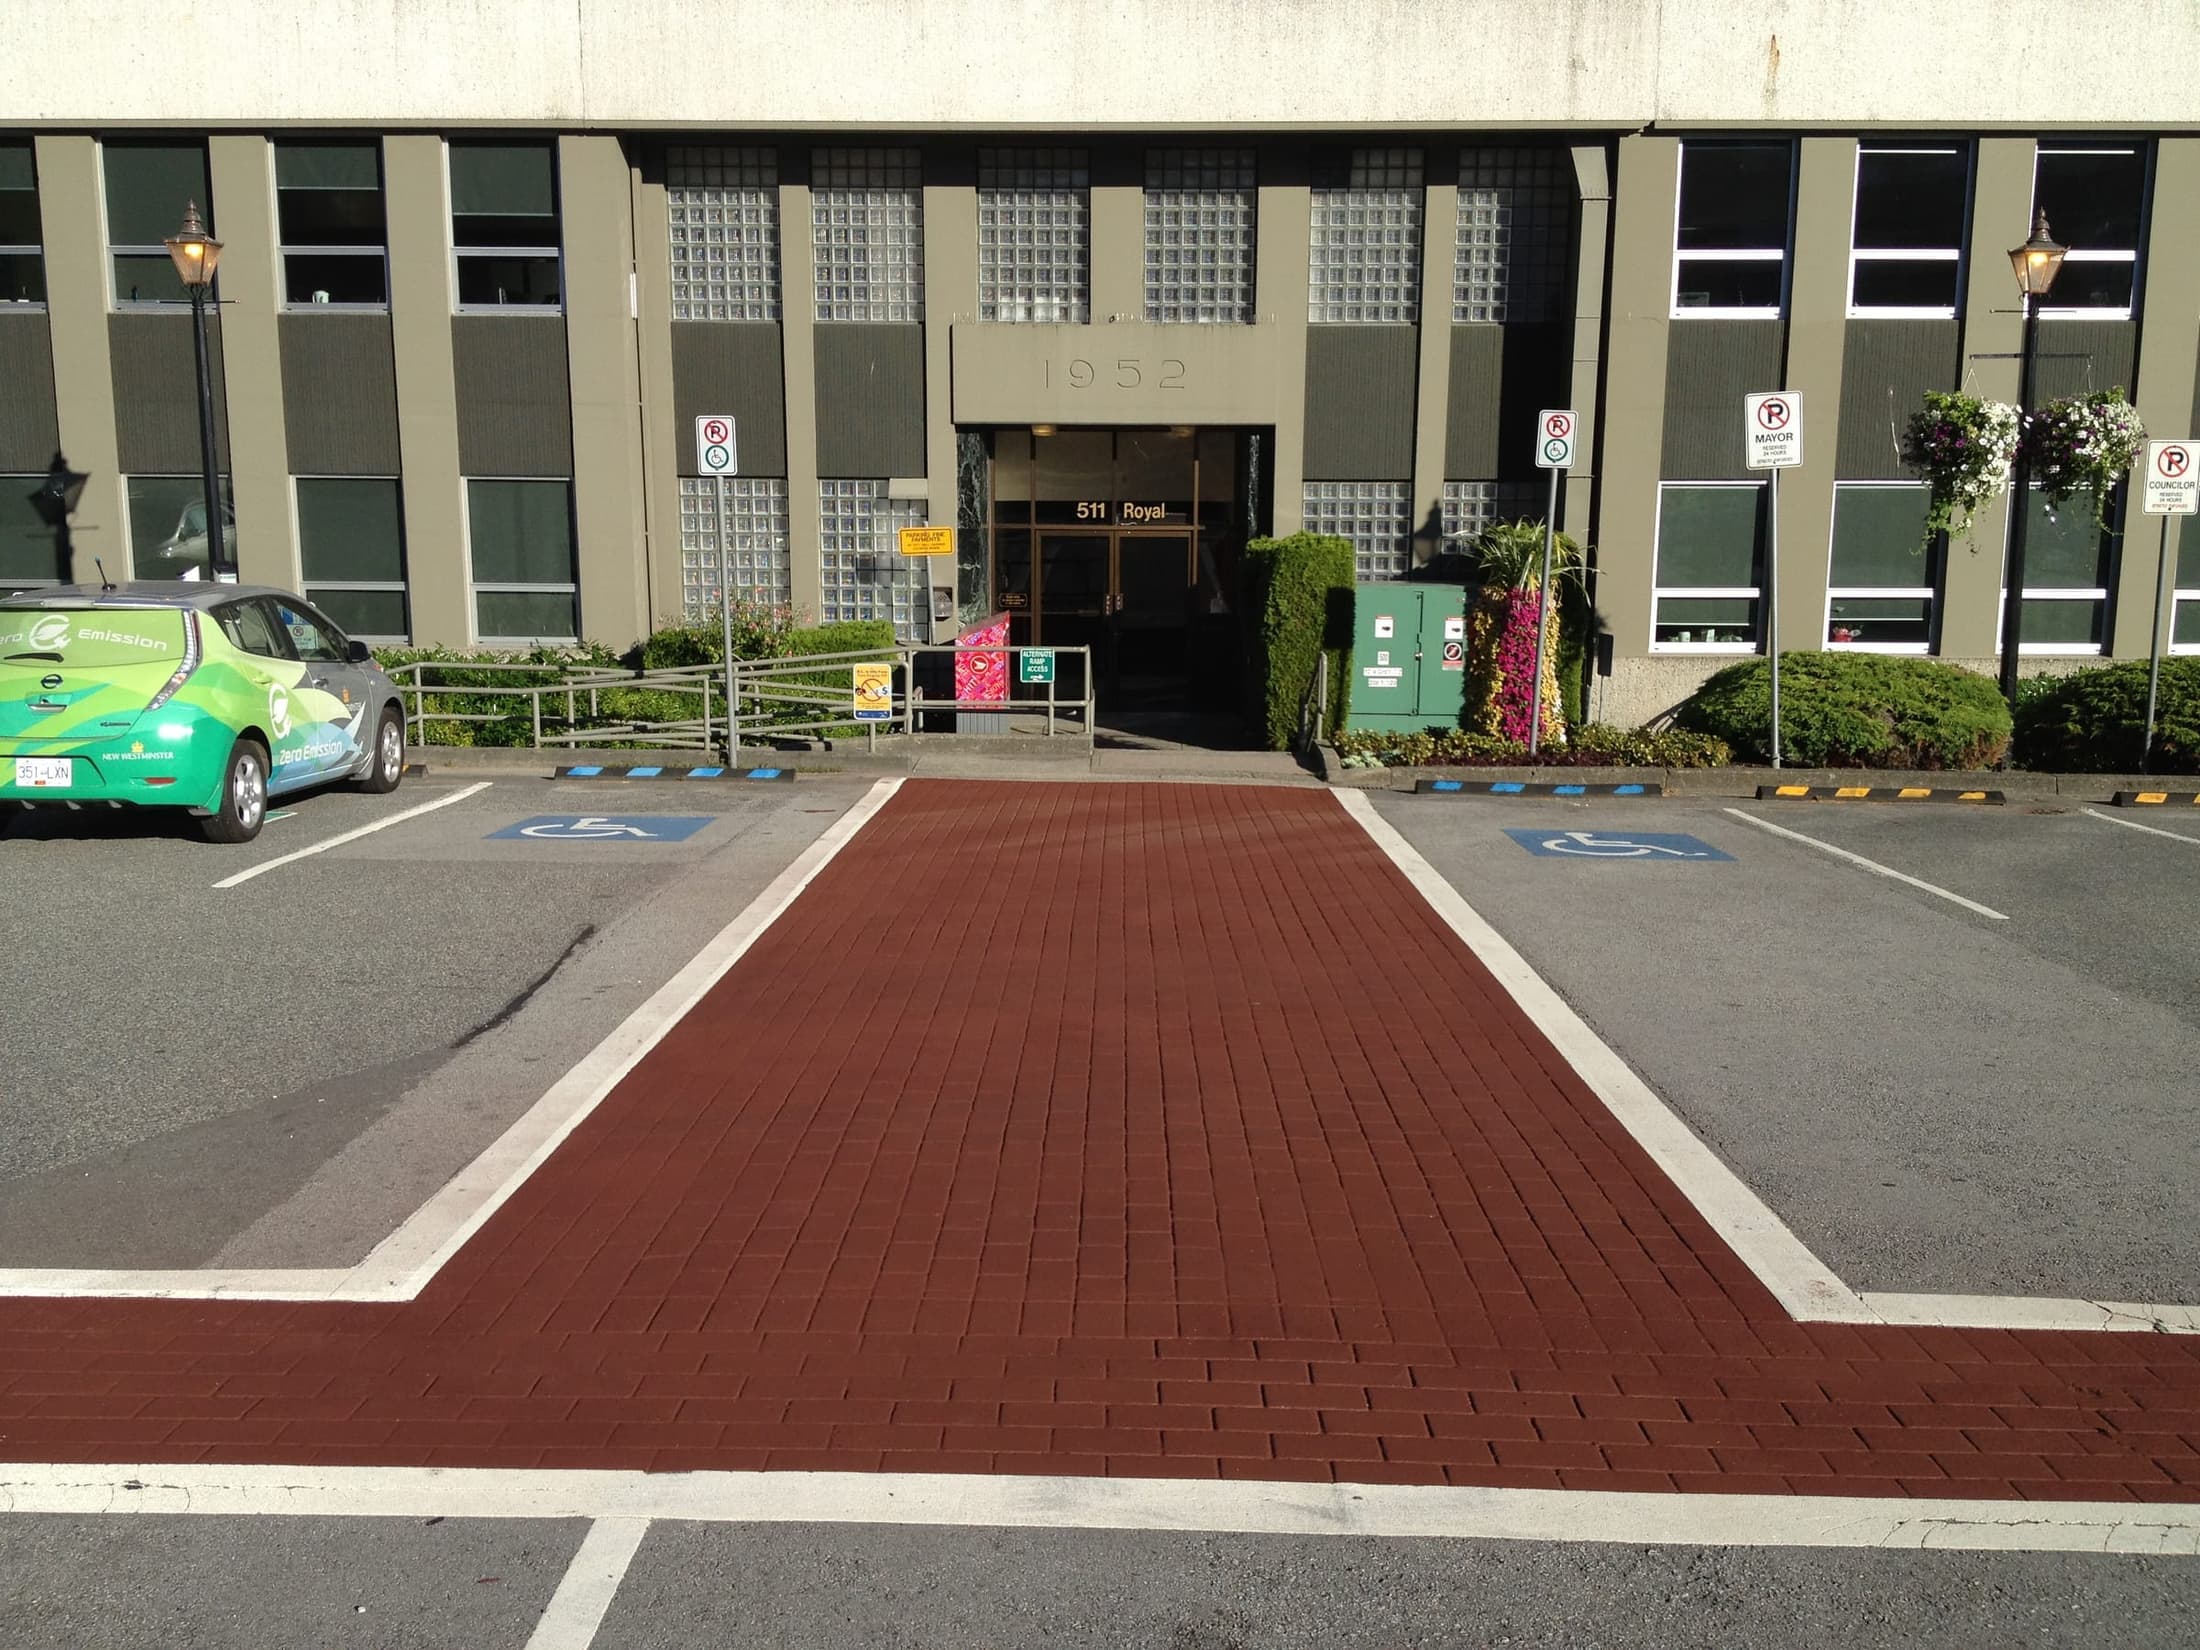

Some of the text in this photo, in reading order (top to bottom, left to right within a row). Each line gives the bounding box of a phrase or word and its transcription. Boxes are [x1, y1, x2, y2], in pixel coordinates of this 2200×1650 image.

[1045, 359, 1185, 389] 1952
[1755, 432, 1794, 443] MAYOR
[2149, 481, 2195, 489] COUNCILOR
[1076, 502, 1165, 522] 511 Royal
[78, 628, 168, 651] Emission
[102, 752, 175, 760] NEW WESTMINSTER
[279, 739, 344, 765] Zero Emission
[18, 765, 69, 779] 351 LXN
